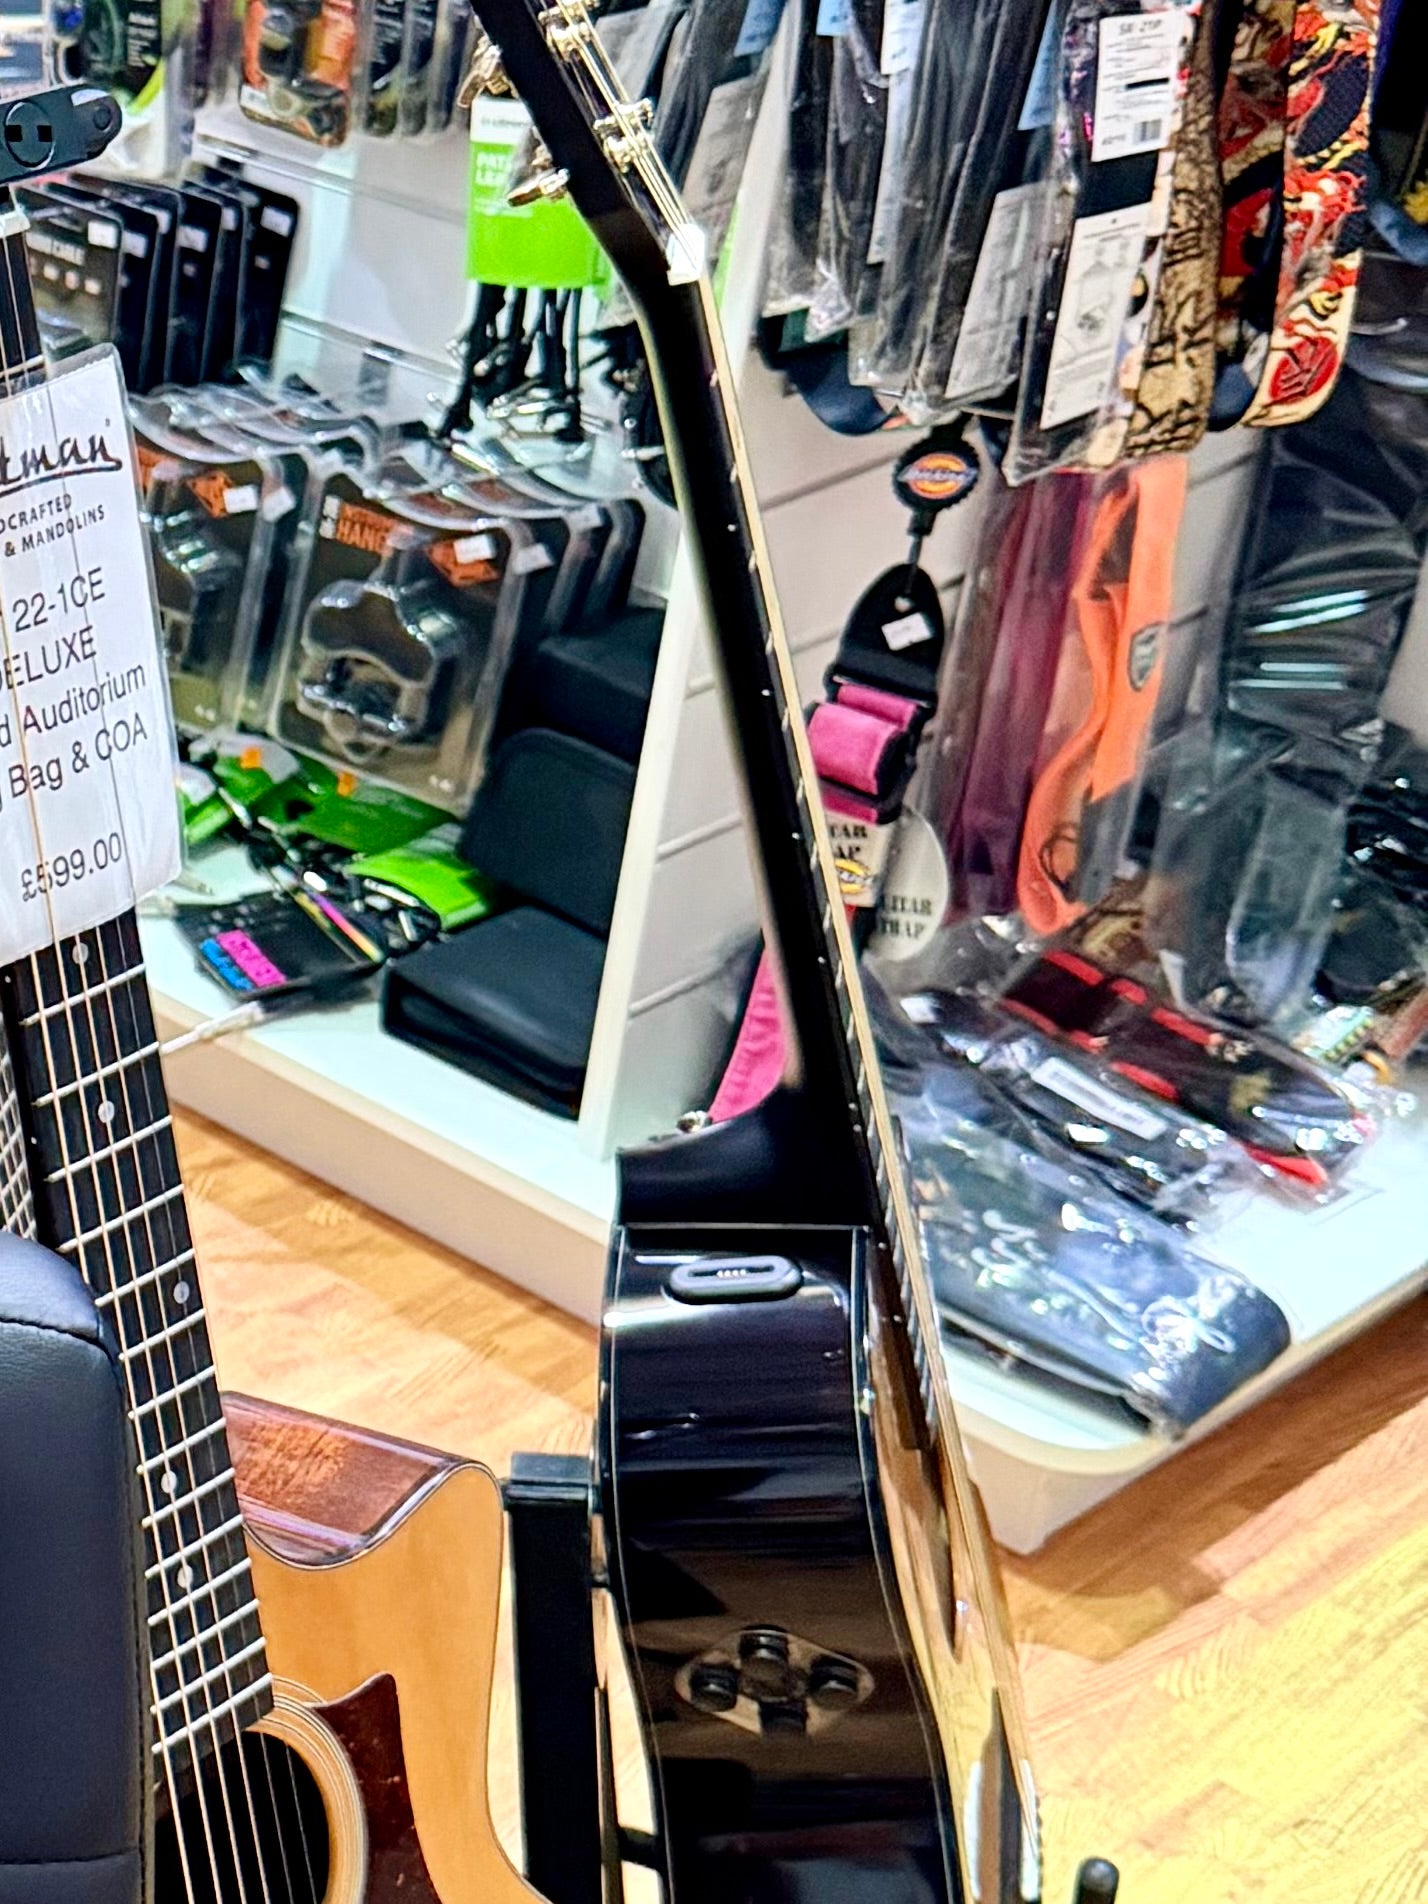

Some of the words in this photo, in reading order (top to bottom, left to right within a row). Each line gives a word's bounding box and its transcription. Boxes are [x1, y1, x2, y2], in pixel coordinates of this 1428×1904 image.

[4, 541, 17, 558] &
[22, 504, 105, 552] MANDOLINS
[21, 663, 146, 737] Auditorium
[9, 757, 64, 800] Bag
[71, 739, 90, 774] &
[95, 712, 148, 762] COA
[21, 831, 123, 902] £599.00
